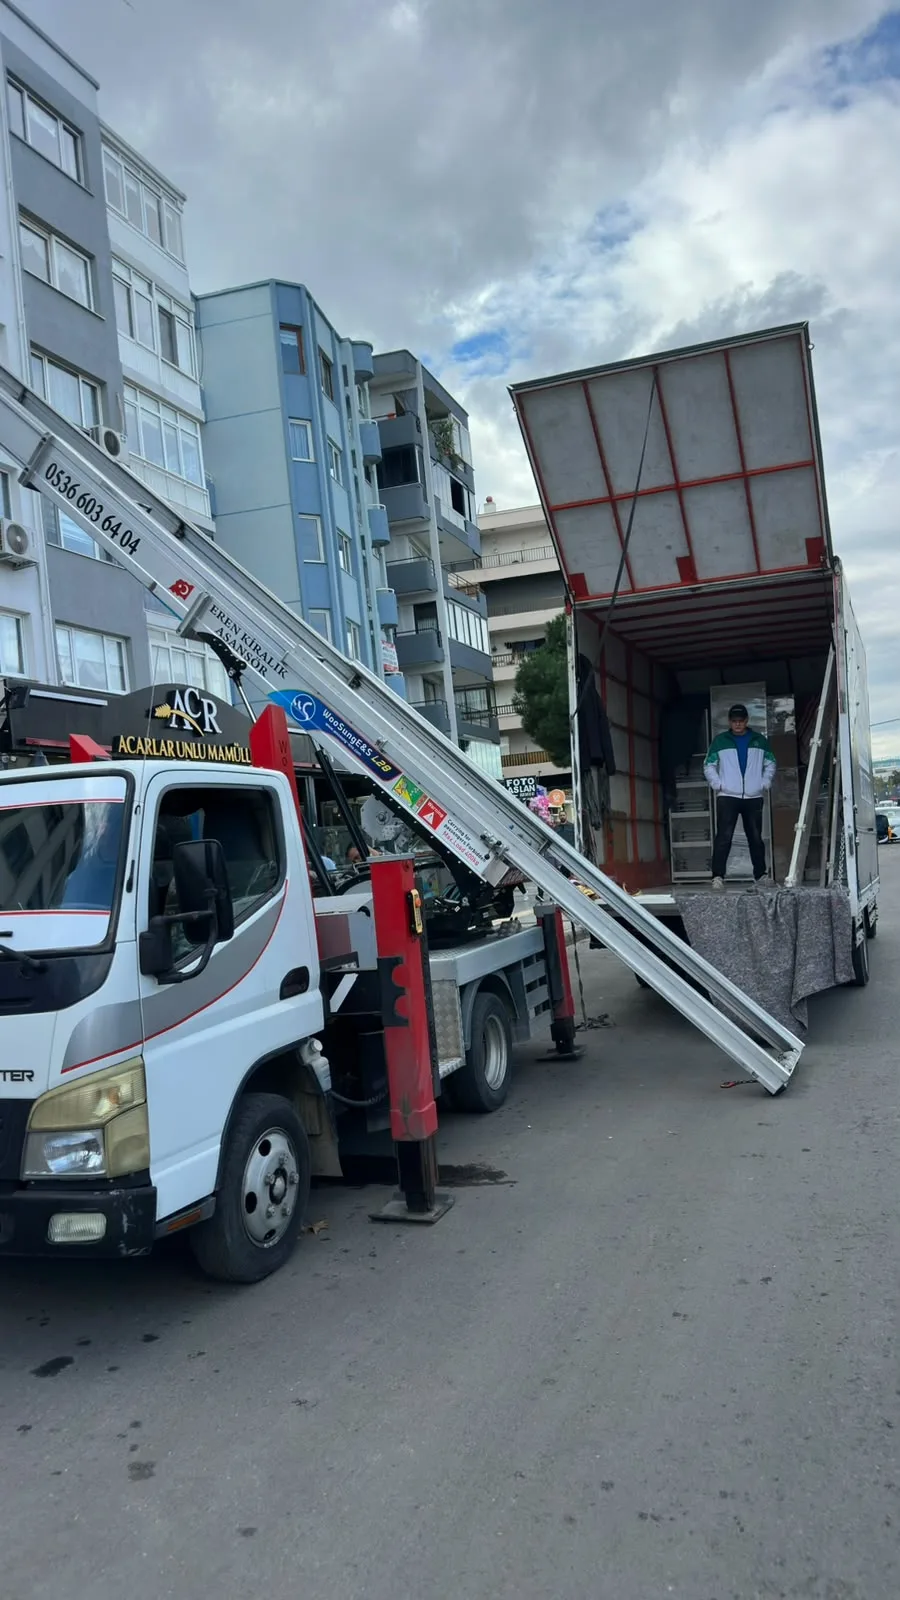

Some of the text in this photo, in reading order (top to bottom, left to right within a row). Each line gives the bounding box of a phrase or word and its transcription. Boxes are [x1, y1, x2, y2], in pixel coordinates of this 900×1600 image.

[45, 463, 141, 555] 0536 603 64 04
[209, 604, 288, 679] EREN KİRALIK
[215, 627, 268, 677] ASANSÖR
[169, 688, 222, 734] ACR
[118, 735, 174, 757] ACARLAR
[176, 741, 206, 760] UNLU
[506, 777, 535, 787] FOTO
[508, 784, 536, 794] ASLAN
